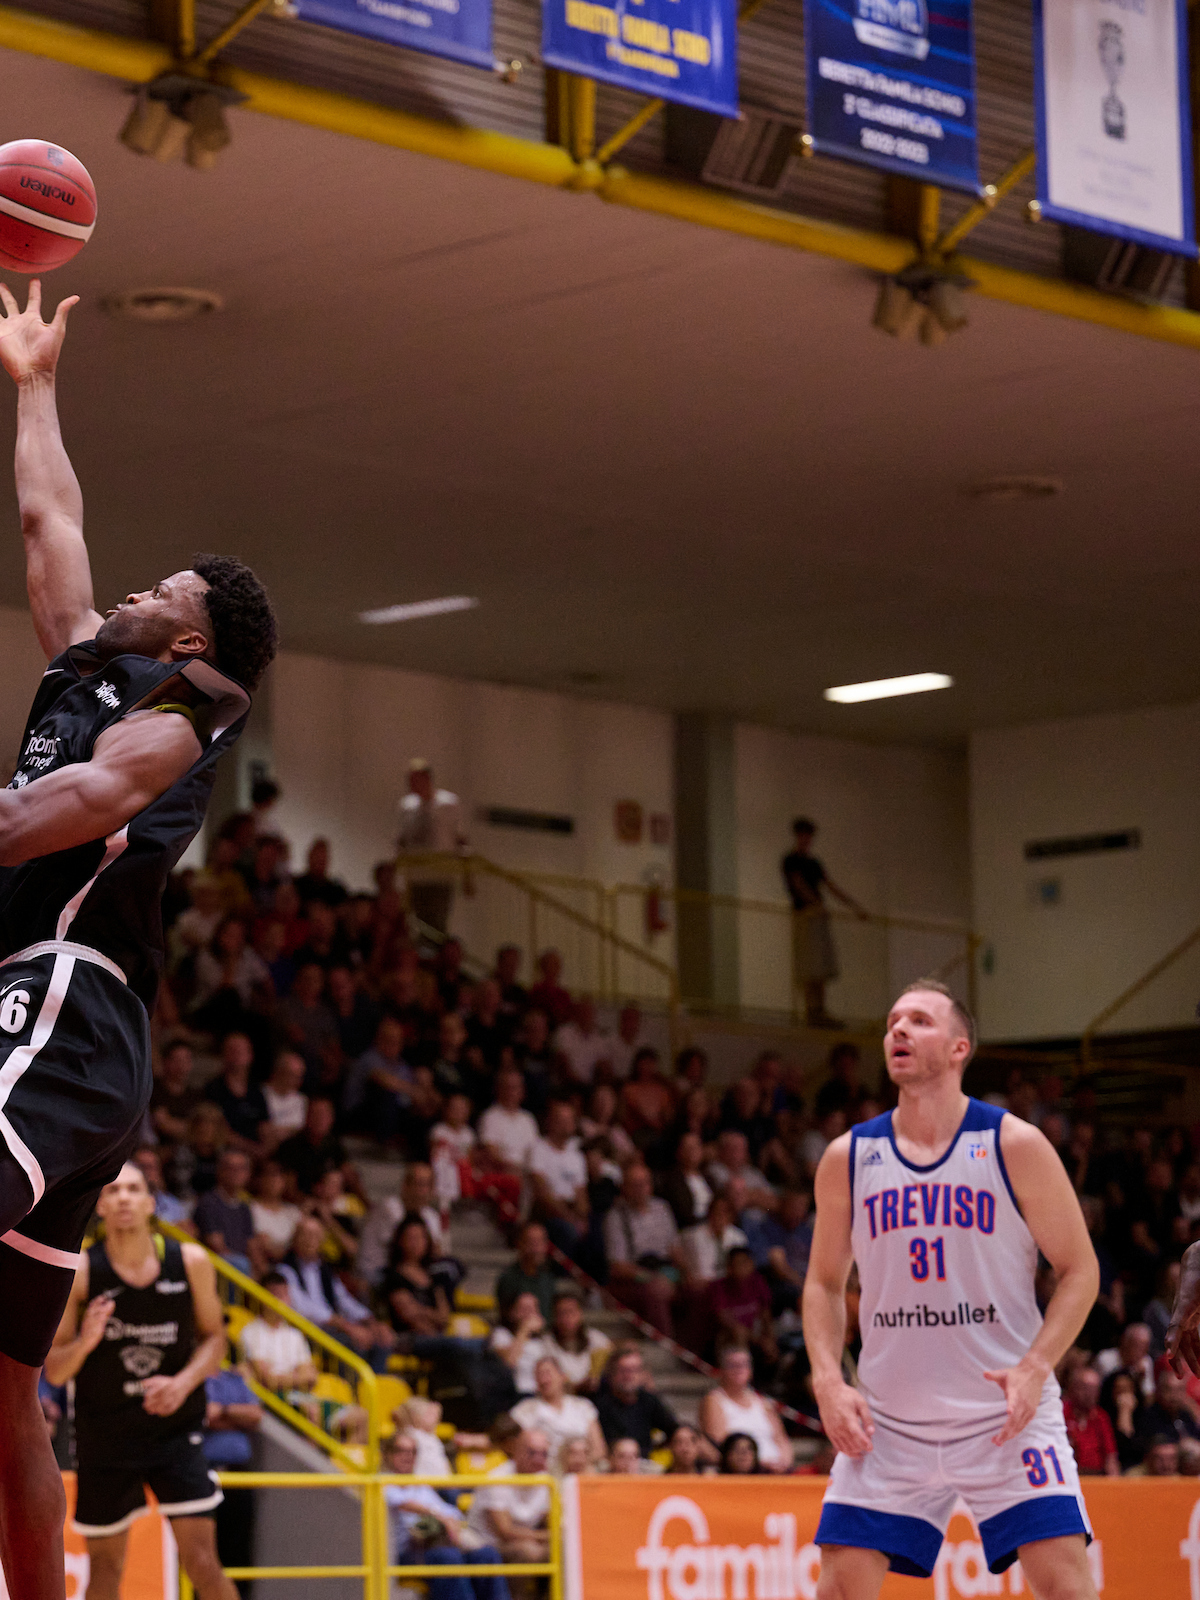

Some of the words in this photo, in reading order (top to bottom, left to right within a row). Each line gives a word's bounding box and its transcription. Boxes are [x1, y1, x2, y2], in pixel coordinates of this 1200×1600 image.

[19, 175, 75, 206] molten
[0, 989, 30, 1034] 6
[864, 1182, 995, 1241] TREVISO
[909, 1235, 947, 1283] 31
[1020, 1444, 1066, 1488] 31
